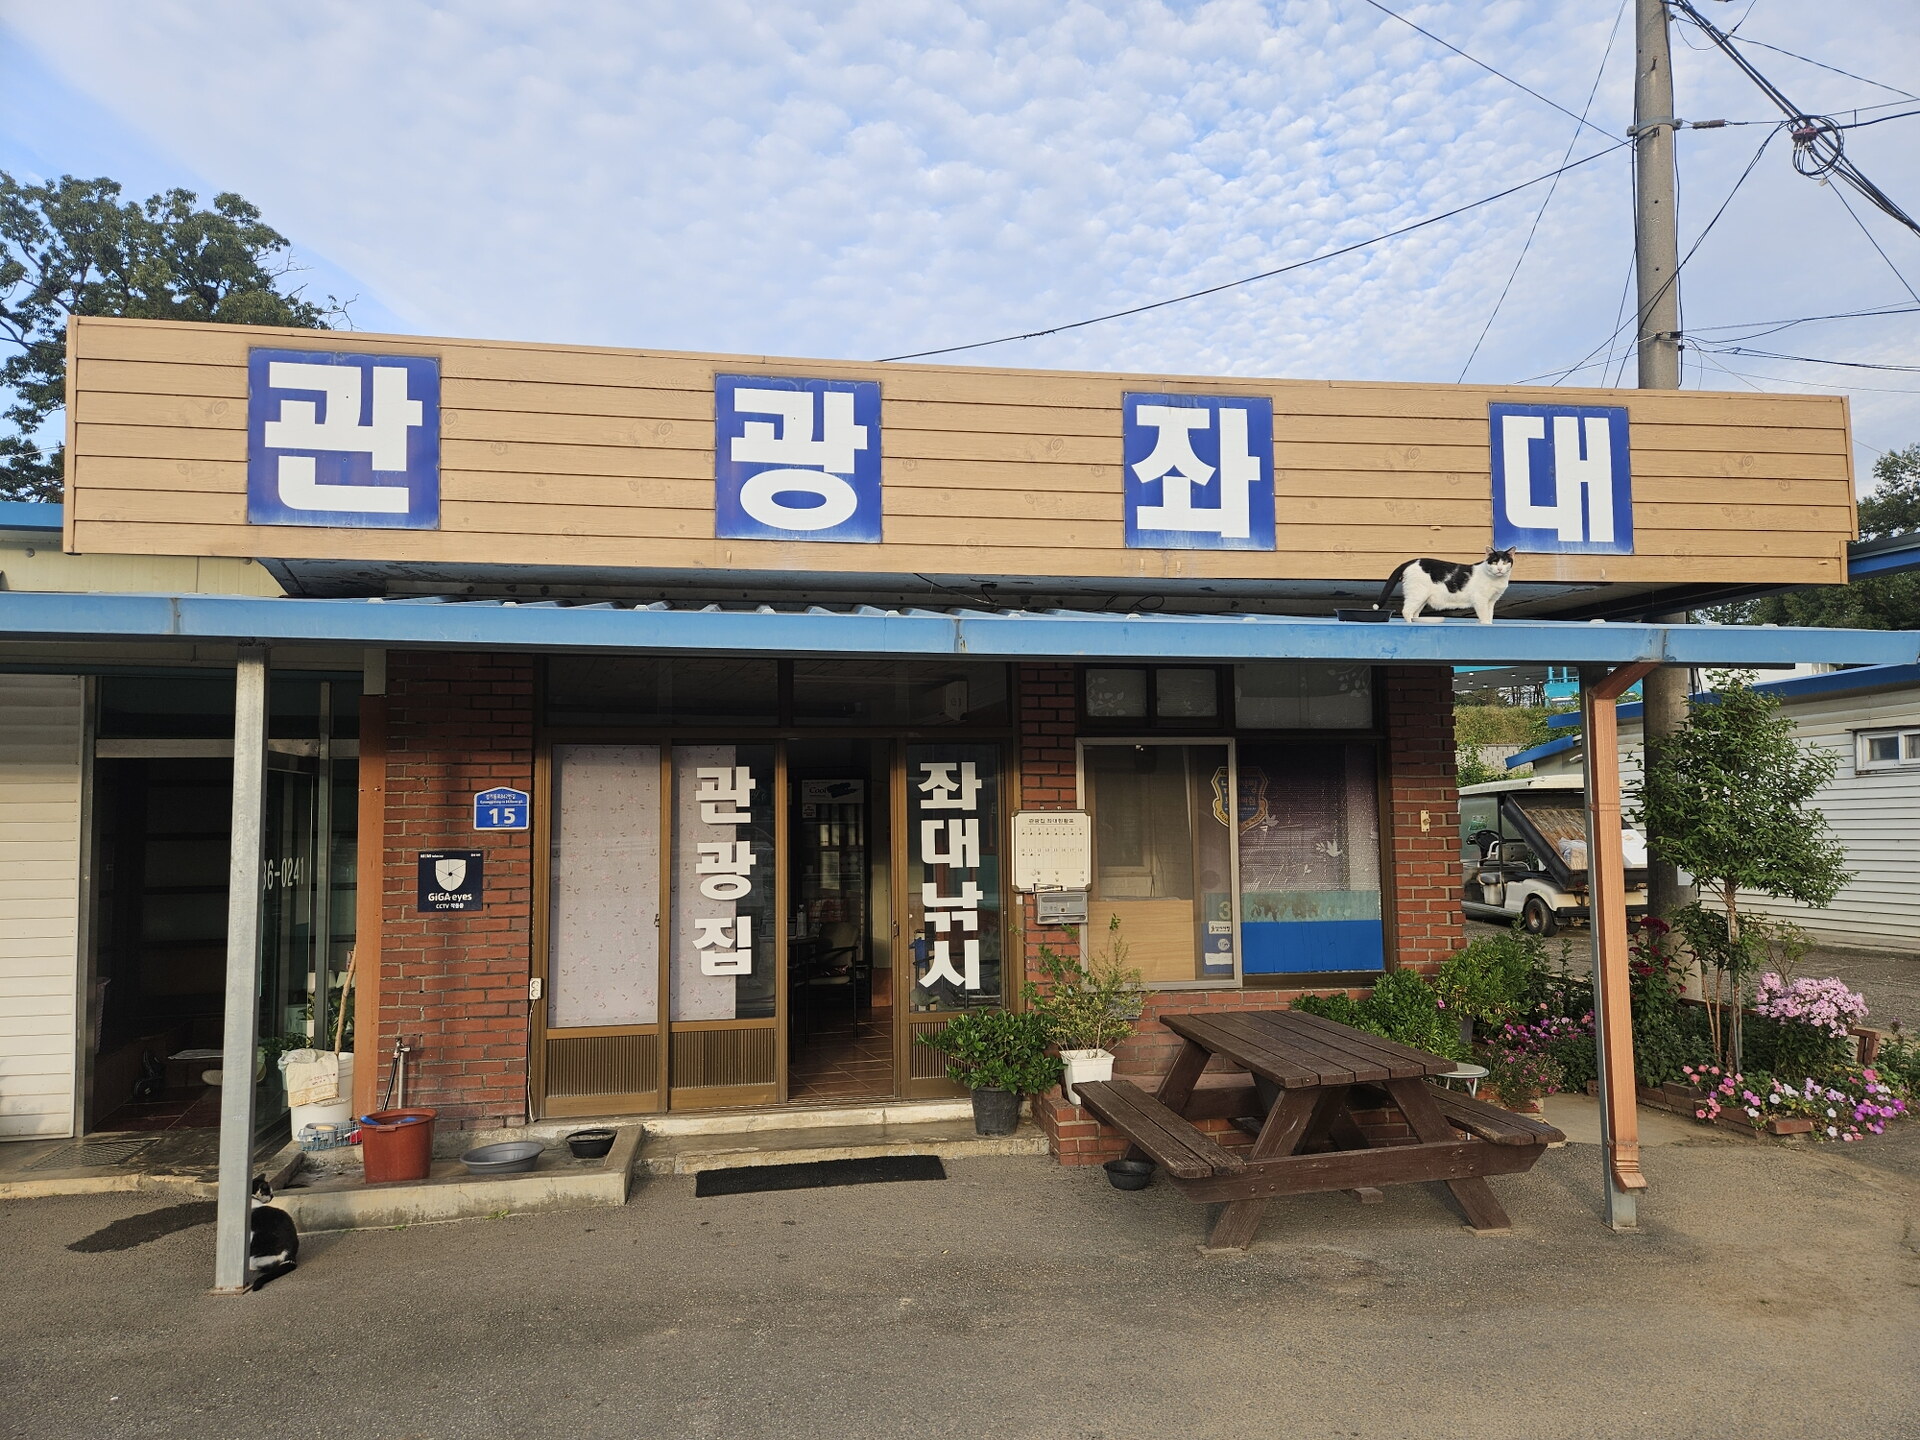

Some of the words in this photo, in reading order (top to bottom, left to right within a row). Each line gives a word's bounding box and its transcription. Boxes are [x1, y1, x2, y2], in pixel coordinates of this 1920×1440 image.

[488, 807, 516, 825] 15
[692, 766, 757, 977] 관광집
[452, 893, 473, 902] eyes
[917, 761, 984, 990] 좌대낚시
